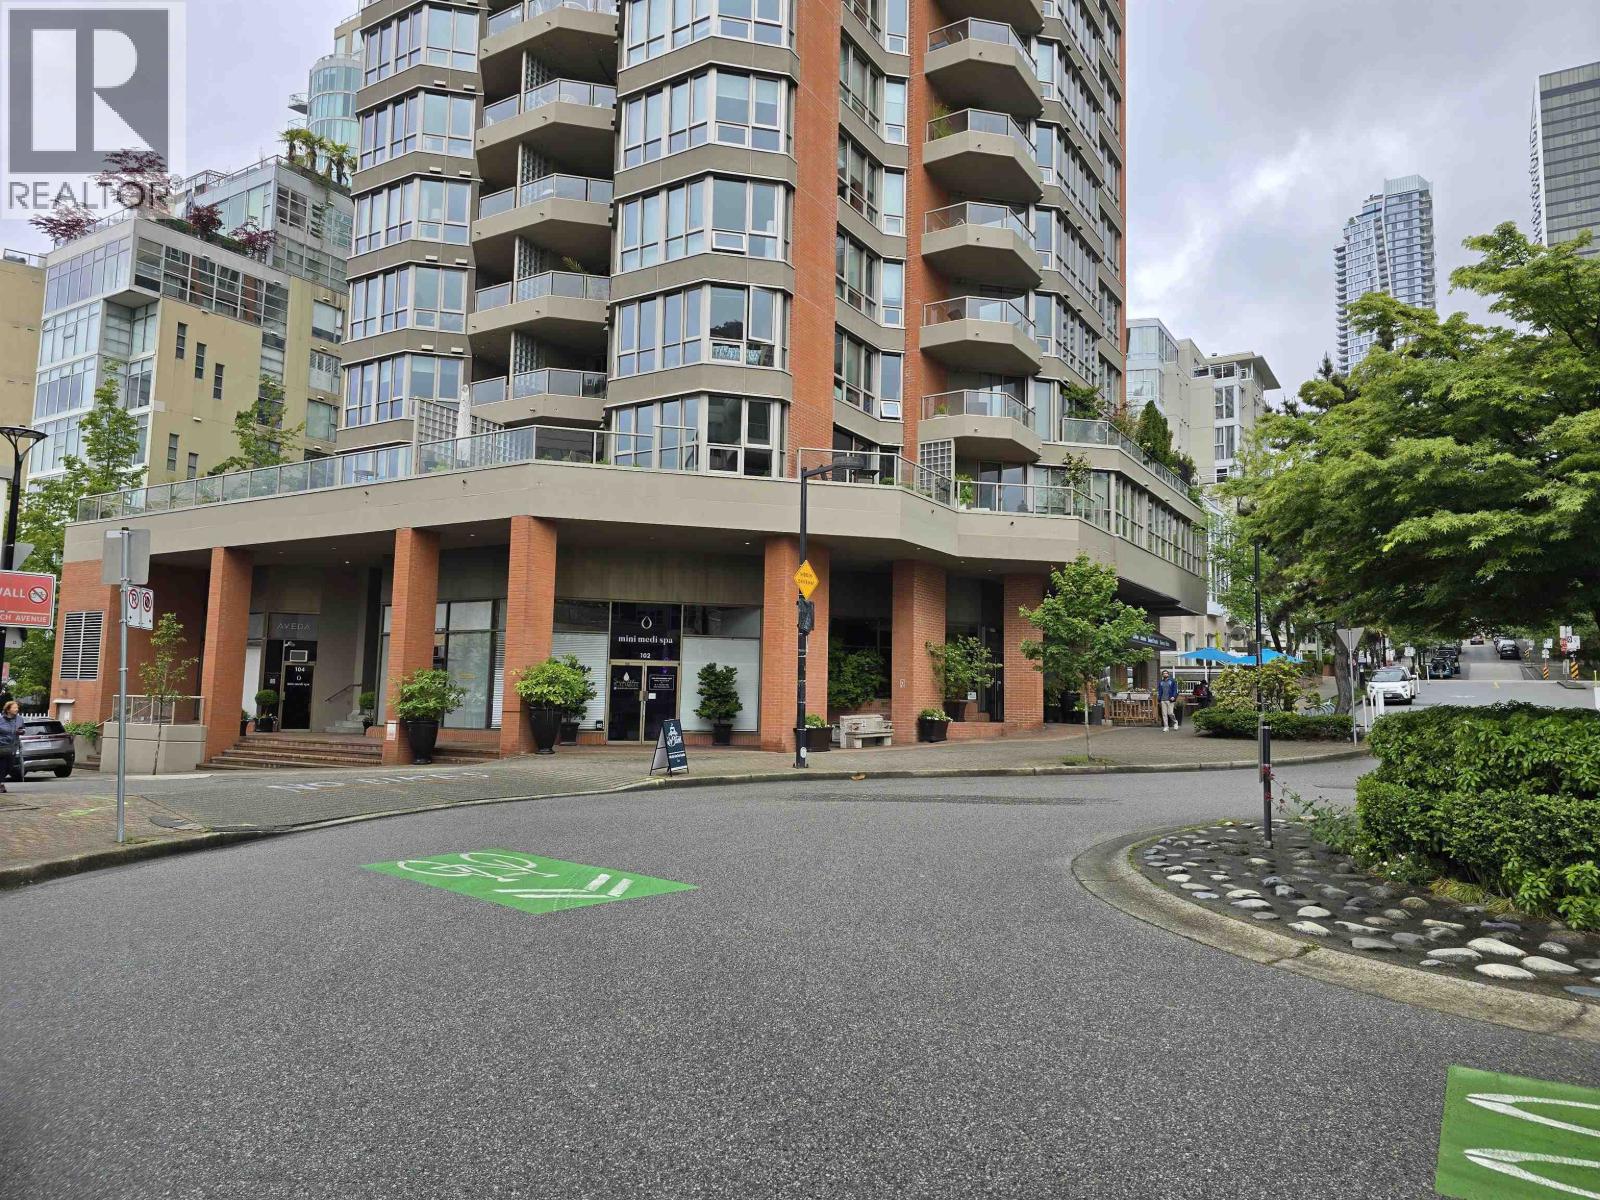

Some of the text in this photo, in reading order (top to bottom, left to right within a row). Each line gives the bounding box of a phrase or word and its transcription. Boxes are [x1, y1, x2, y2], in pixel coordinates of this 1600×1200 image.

[0, 587, 26, 598] ALL
[16, 614, 48, 623] AVENUE
[276, 623, 312, 631] AVEDA
[618, 634, 673, 646] mini medi spa
